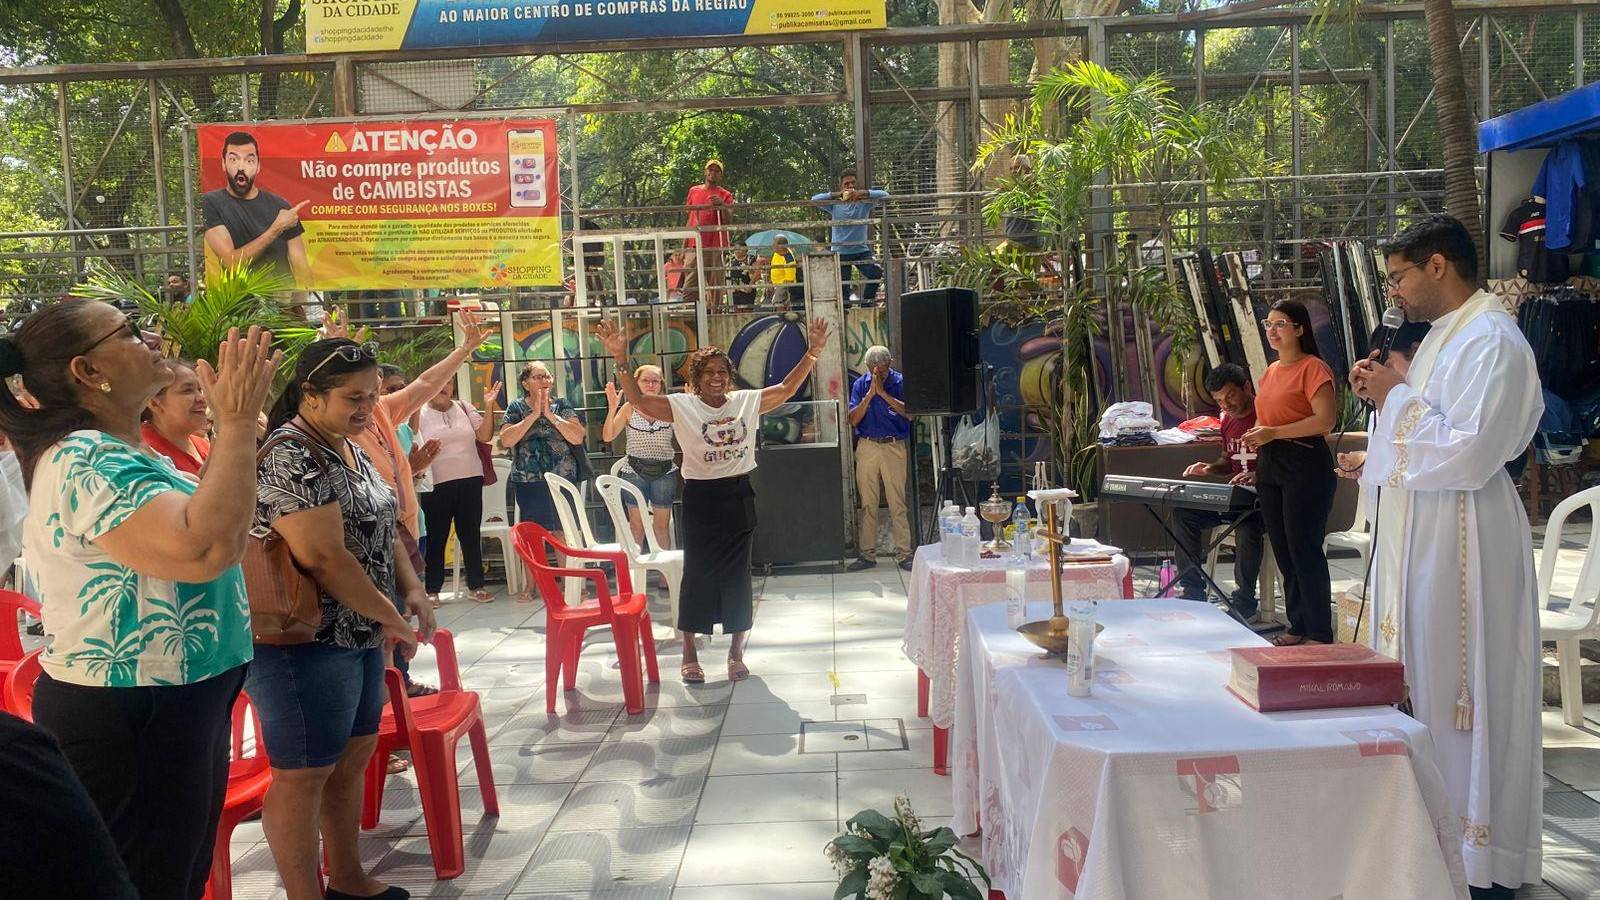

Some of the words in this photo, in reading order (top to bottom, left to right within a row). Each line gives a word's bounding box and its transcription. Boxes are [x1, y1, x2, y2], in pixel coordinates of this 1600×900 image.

[323, 6, 342, 17] DA
[346, 3, 400, 17] CIDADE
[440, 11, 458, 23] AO
[463, 9, 509, 22] MAIOR
[514, 6, 568, 20] CENTRO
[575, 4, 592, 16] DE
[597, 0, 666, 14] COMPRAS
[672, 0, 690, 12] DA
[350, 124, 478, 155] ATENÇÃO
[301, 160, 337, 178] Não
[342, 162, 412, 180] compre
[416, 158, 500, 180] produtos
[332, 183, 354, 200] de
[360, 180, 472, 200] CAMBISTAS
[311, 205, 353, 214] COMPRE
[355, 205, 378, 214] COM
[380, 204, 438, 215] SEGURANÇA
[440, 204, 460, 212] NOS
[462, 203, 496, 212] BOXES!
[508, 265, 552, 274] SHOPPING
[1327, 682, 1361, 692] ROMANO
